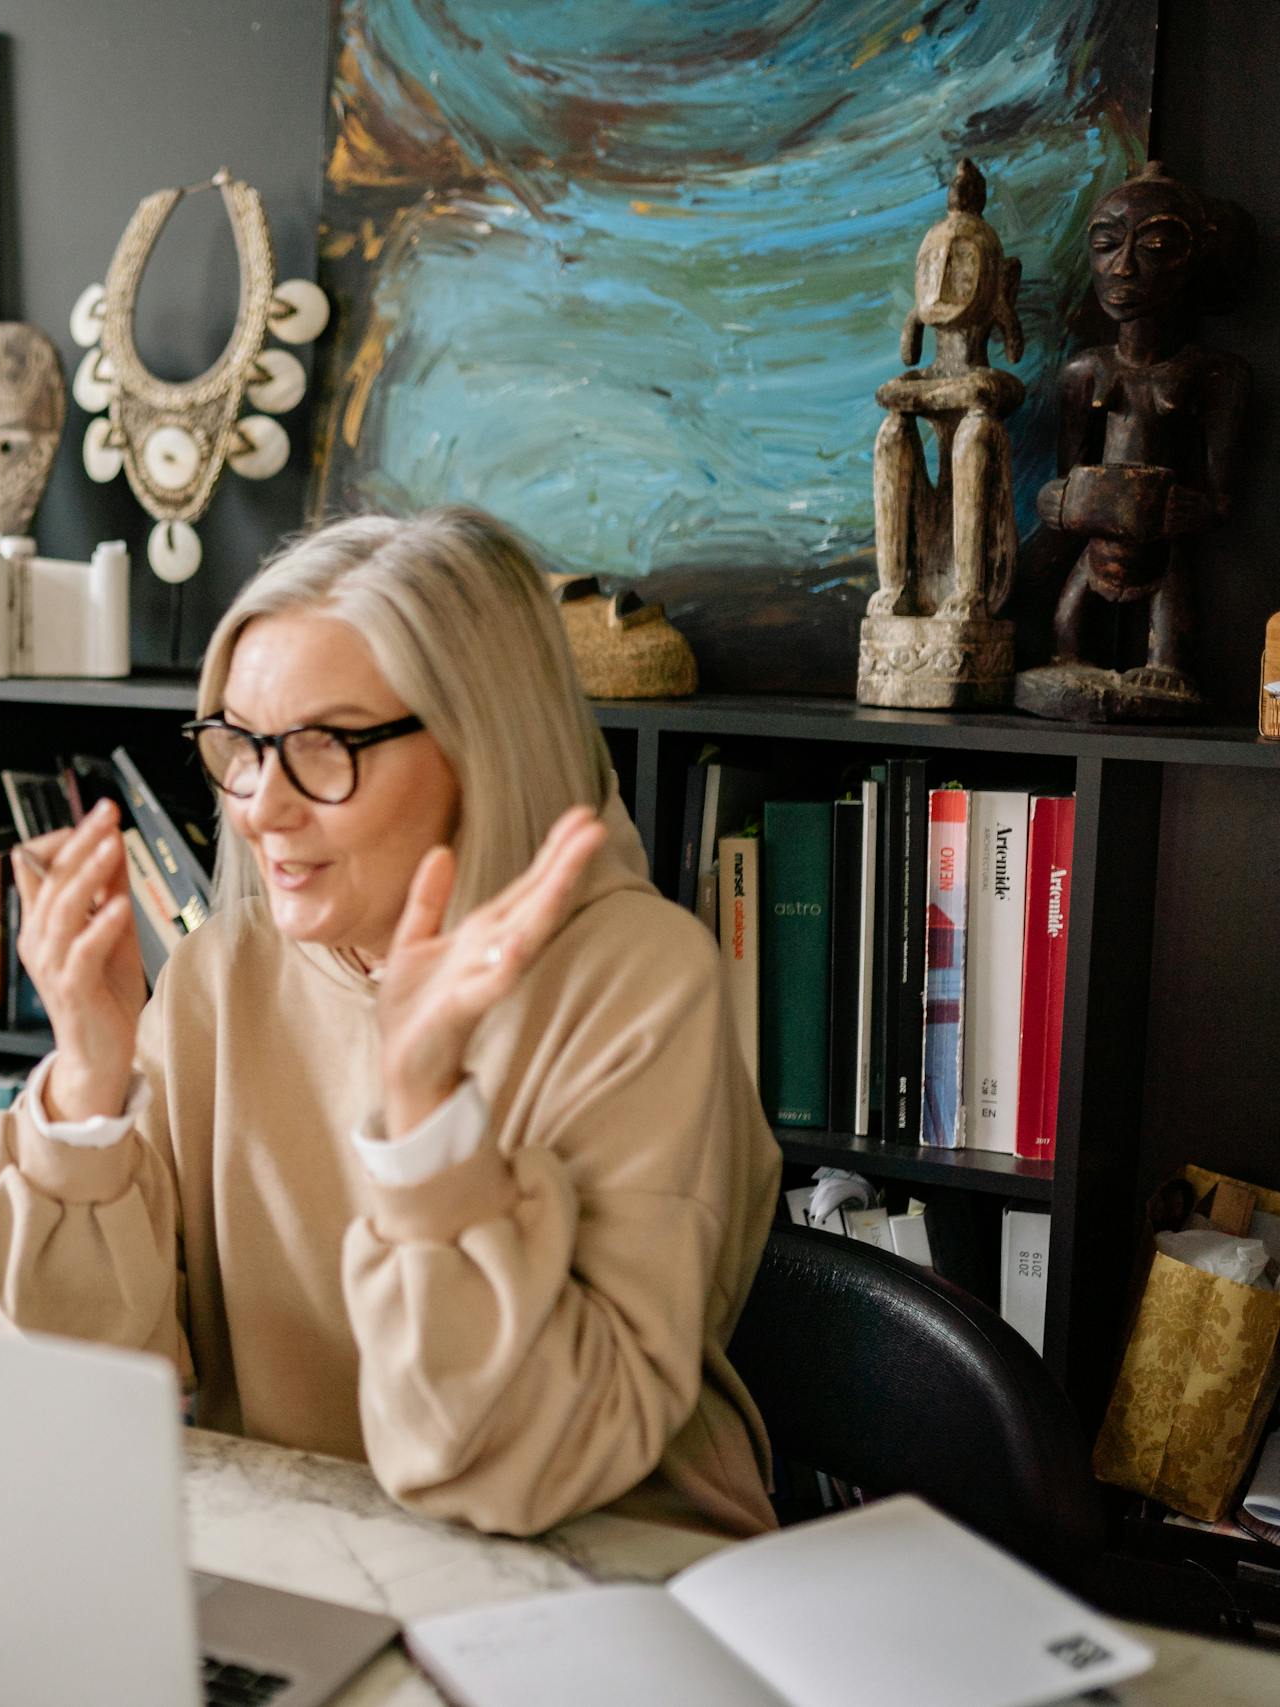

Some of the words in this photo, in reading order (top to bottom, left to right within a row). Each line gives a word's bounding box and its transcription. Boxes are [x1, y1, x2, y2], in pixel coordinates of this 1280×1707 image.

[733, 852, 746, 897] marset
[939, 847, 955, 892] NEMO
[994, 822, 1012, 901] Artemide
[774, 902, 822, 916] astro
[1047, 864, 1067, 937] Artemide
[981, 1108, 997, 1118] EN
[1034, 1137, 1051, 1145] 2017
[1018, 1251, 1030, 1277] 2018
[1031, 1252, 1043, 1278] 2019
